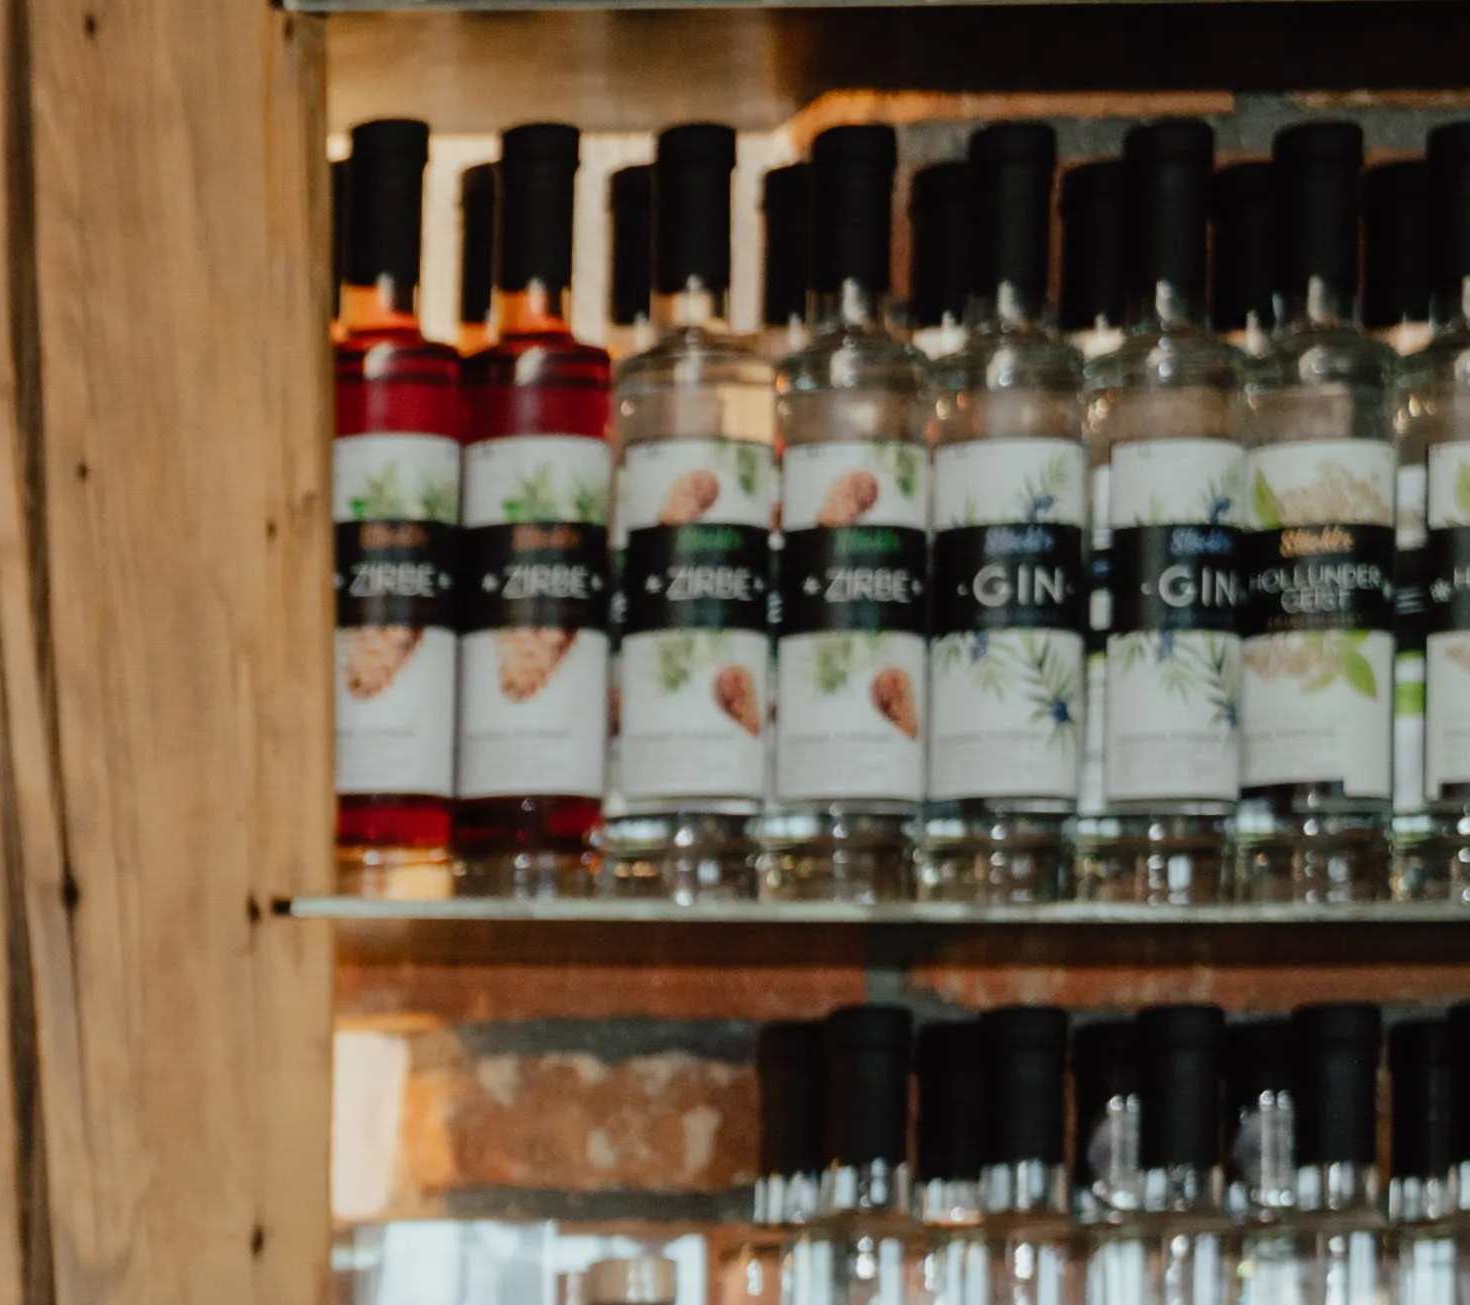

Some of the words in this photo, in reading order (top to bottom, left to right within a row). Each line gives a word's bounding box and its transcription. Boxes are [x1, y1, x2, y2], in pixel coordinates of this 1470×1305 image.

[350, 563, 436, 597] ZIRBE
[501, 564, 587, 598] ZIRBE
[666, 566, 751, 600] ZIRBE
[825, 566, 910, 602] ZIRBE
[972, 564, 1065, 607] GIN
[1158, 564, 1236, 608] GIN
